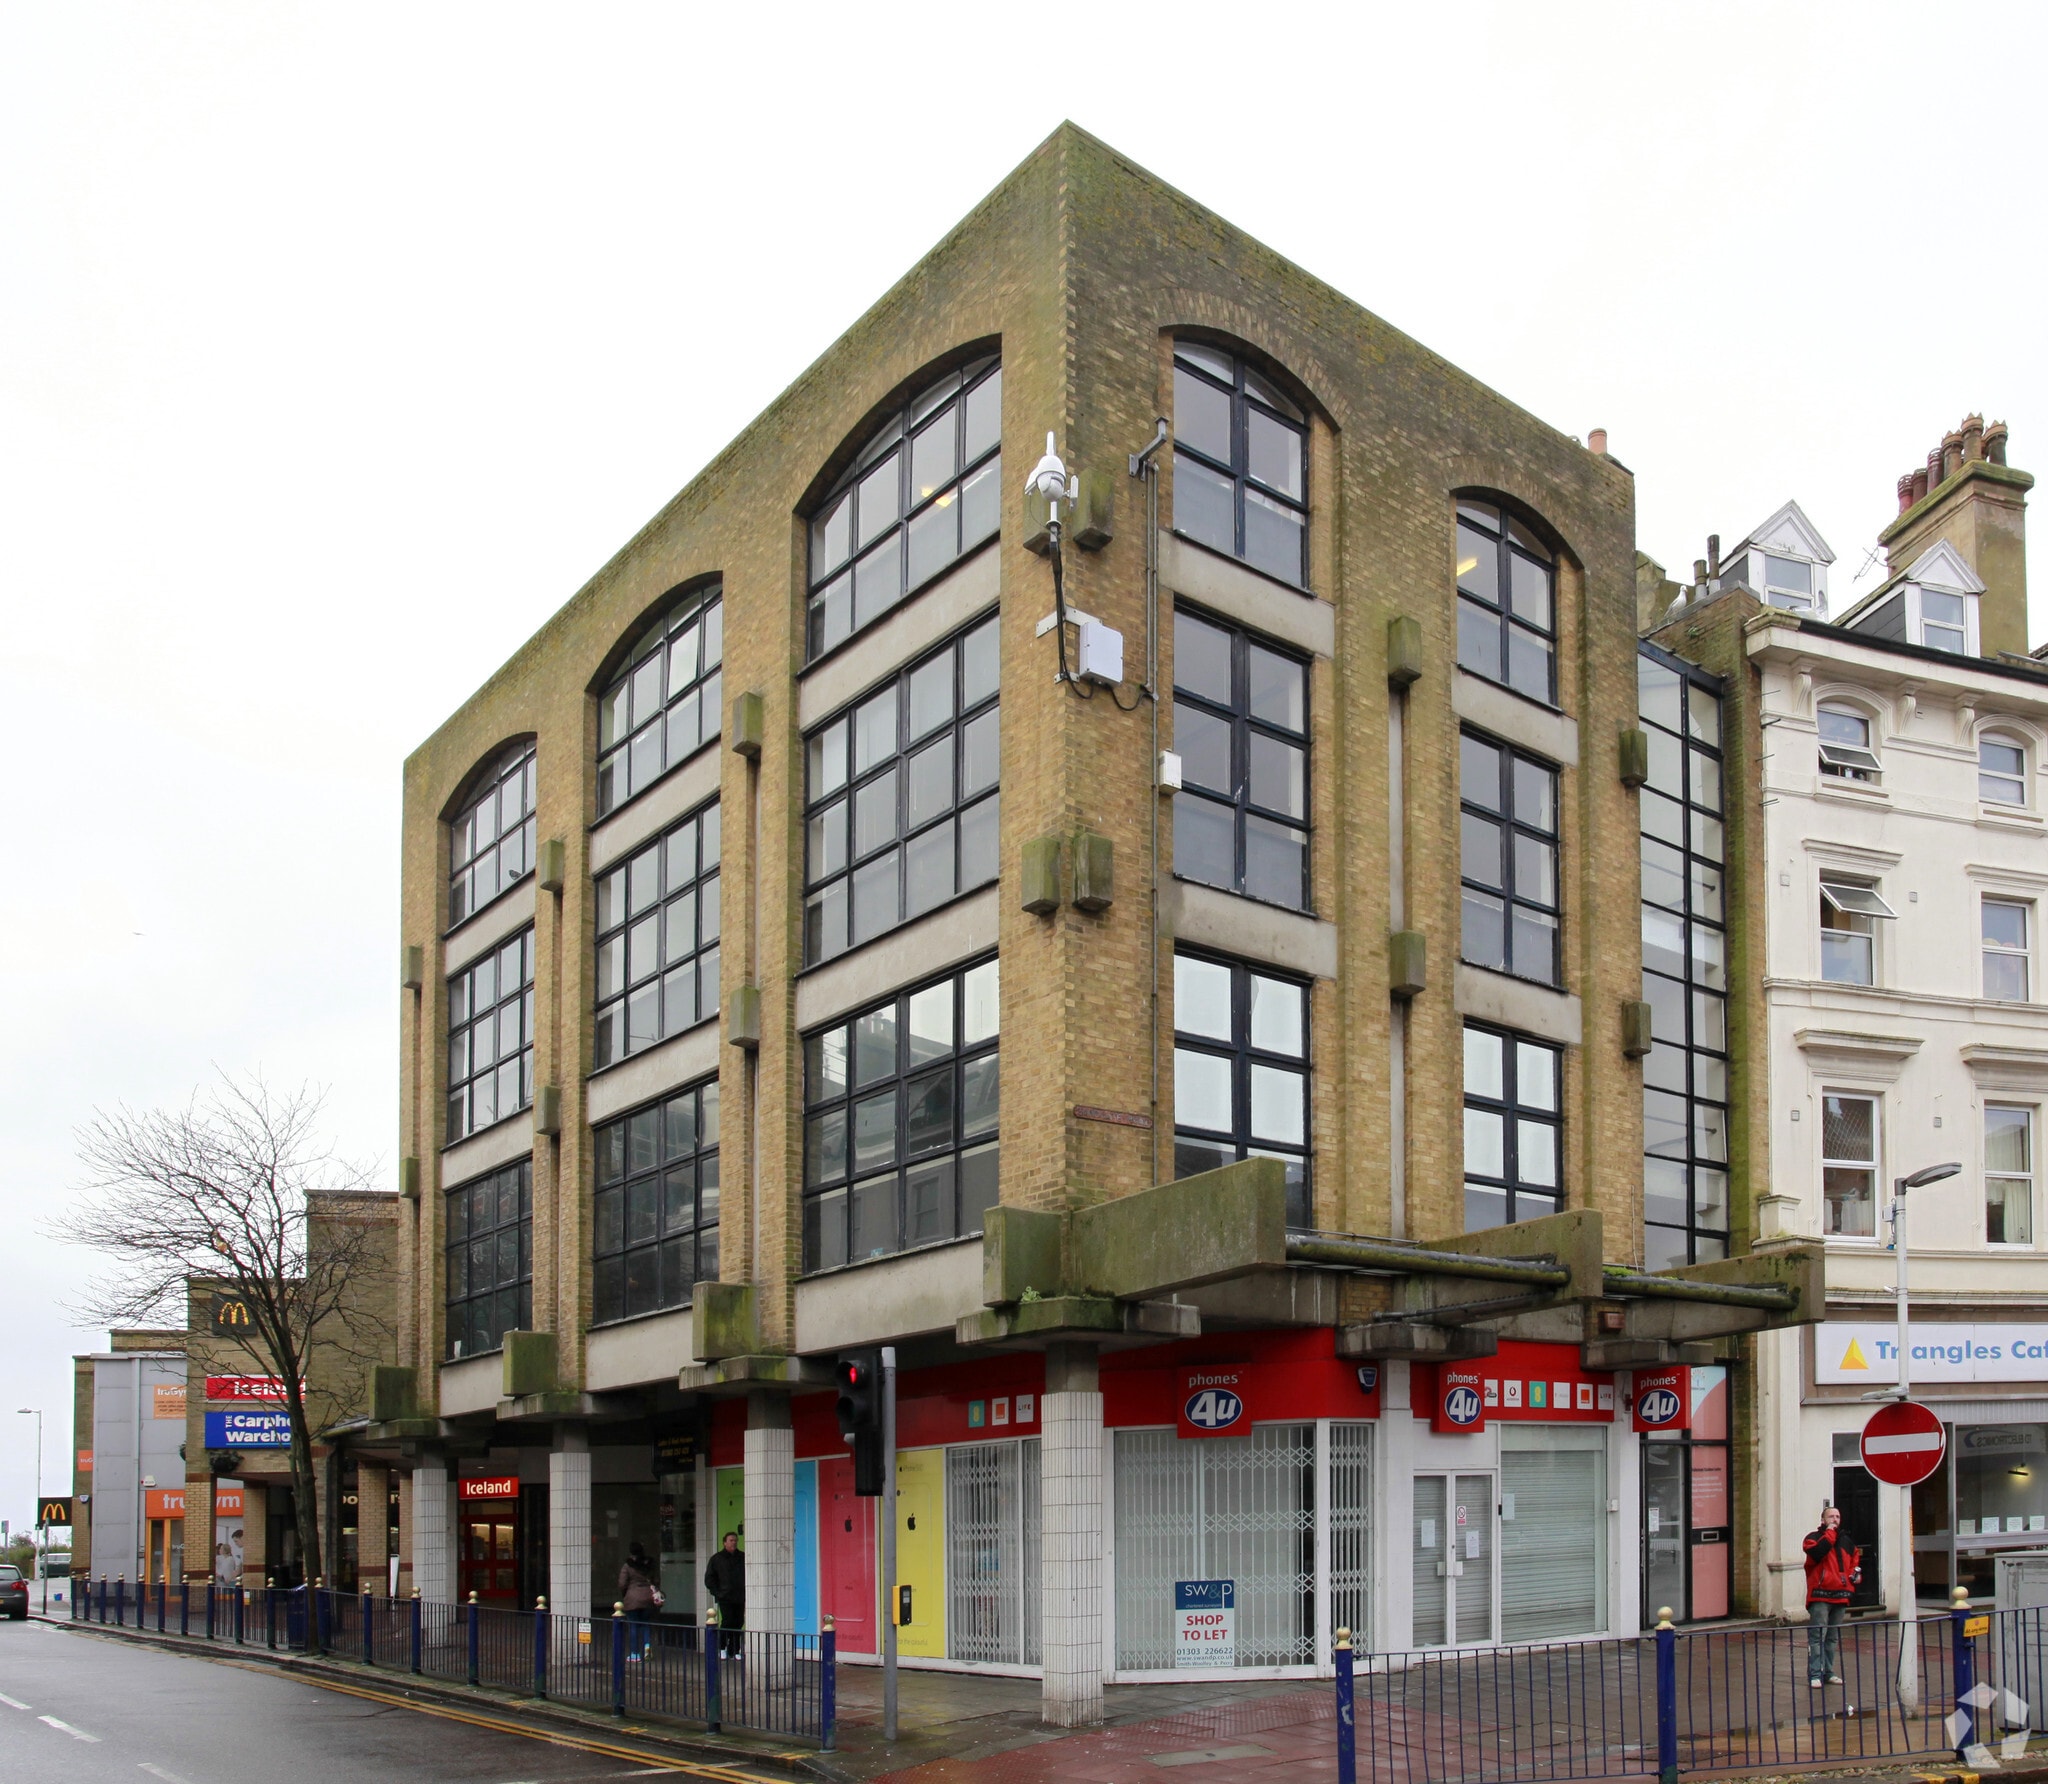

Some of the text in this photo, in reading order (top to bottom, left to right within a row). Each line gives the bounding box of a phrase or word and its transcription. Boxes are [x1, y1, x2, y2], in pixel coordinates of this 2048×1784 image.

[1875, 1340, 2002, 1364] Trangles
[1189, 1373, 1239, 1389] phones
[1447, 1372, 1479, 1385] phones
[1640, 1375, 1677, 1390] phones
[1191, 1391, 1237, 1427] 4u
[1449, 1389, 1478, 1422] 4u
[1641, 1391, 1675, 1422] 4u
[225, 1415, 233, 1428] THE
[466, 1480, 512, 1495] Iceland
[1186, 1614, 1224, 1626] SHOP
[1182, 1629, 1228, 1641] TO LET
[1176, 1647, 1233, 1656] 01303 226622
